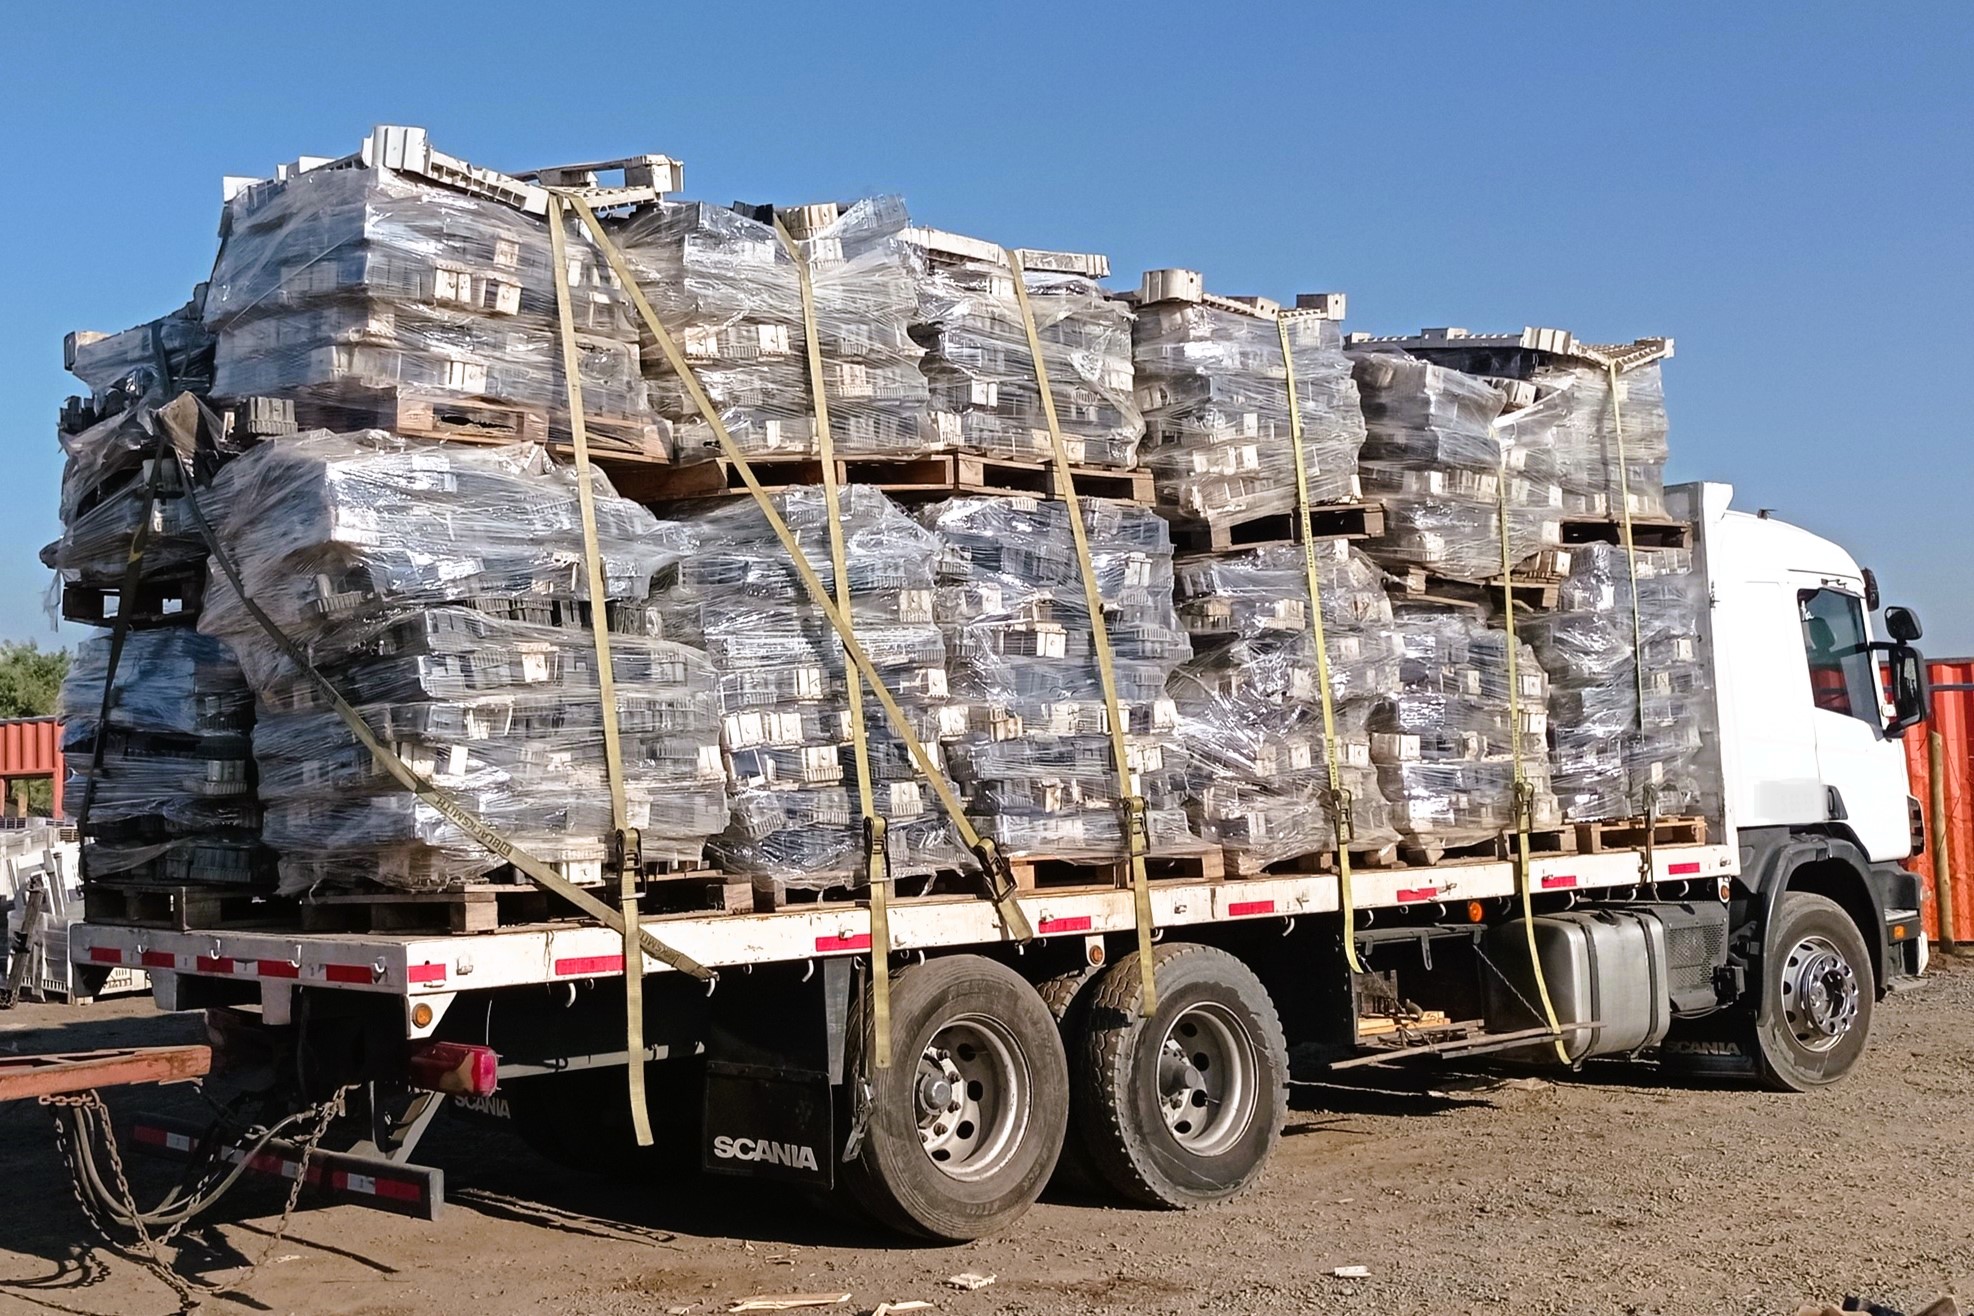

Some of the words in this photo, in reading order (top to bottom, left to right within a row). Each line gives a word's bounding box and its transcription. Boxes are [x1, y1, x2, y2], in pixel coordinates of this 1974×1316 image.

[436, 797, 501, 848] BLACKSMITH
[1665, 1041, 1742, 1056] SCANIA
[713, 1135, 819, 1171] SCANIA
